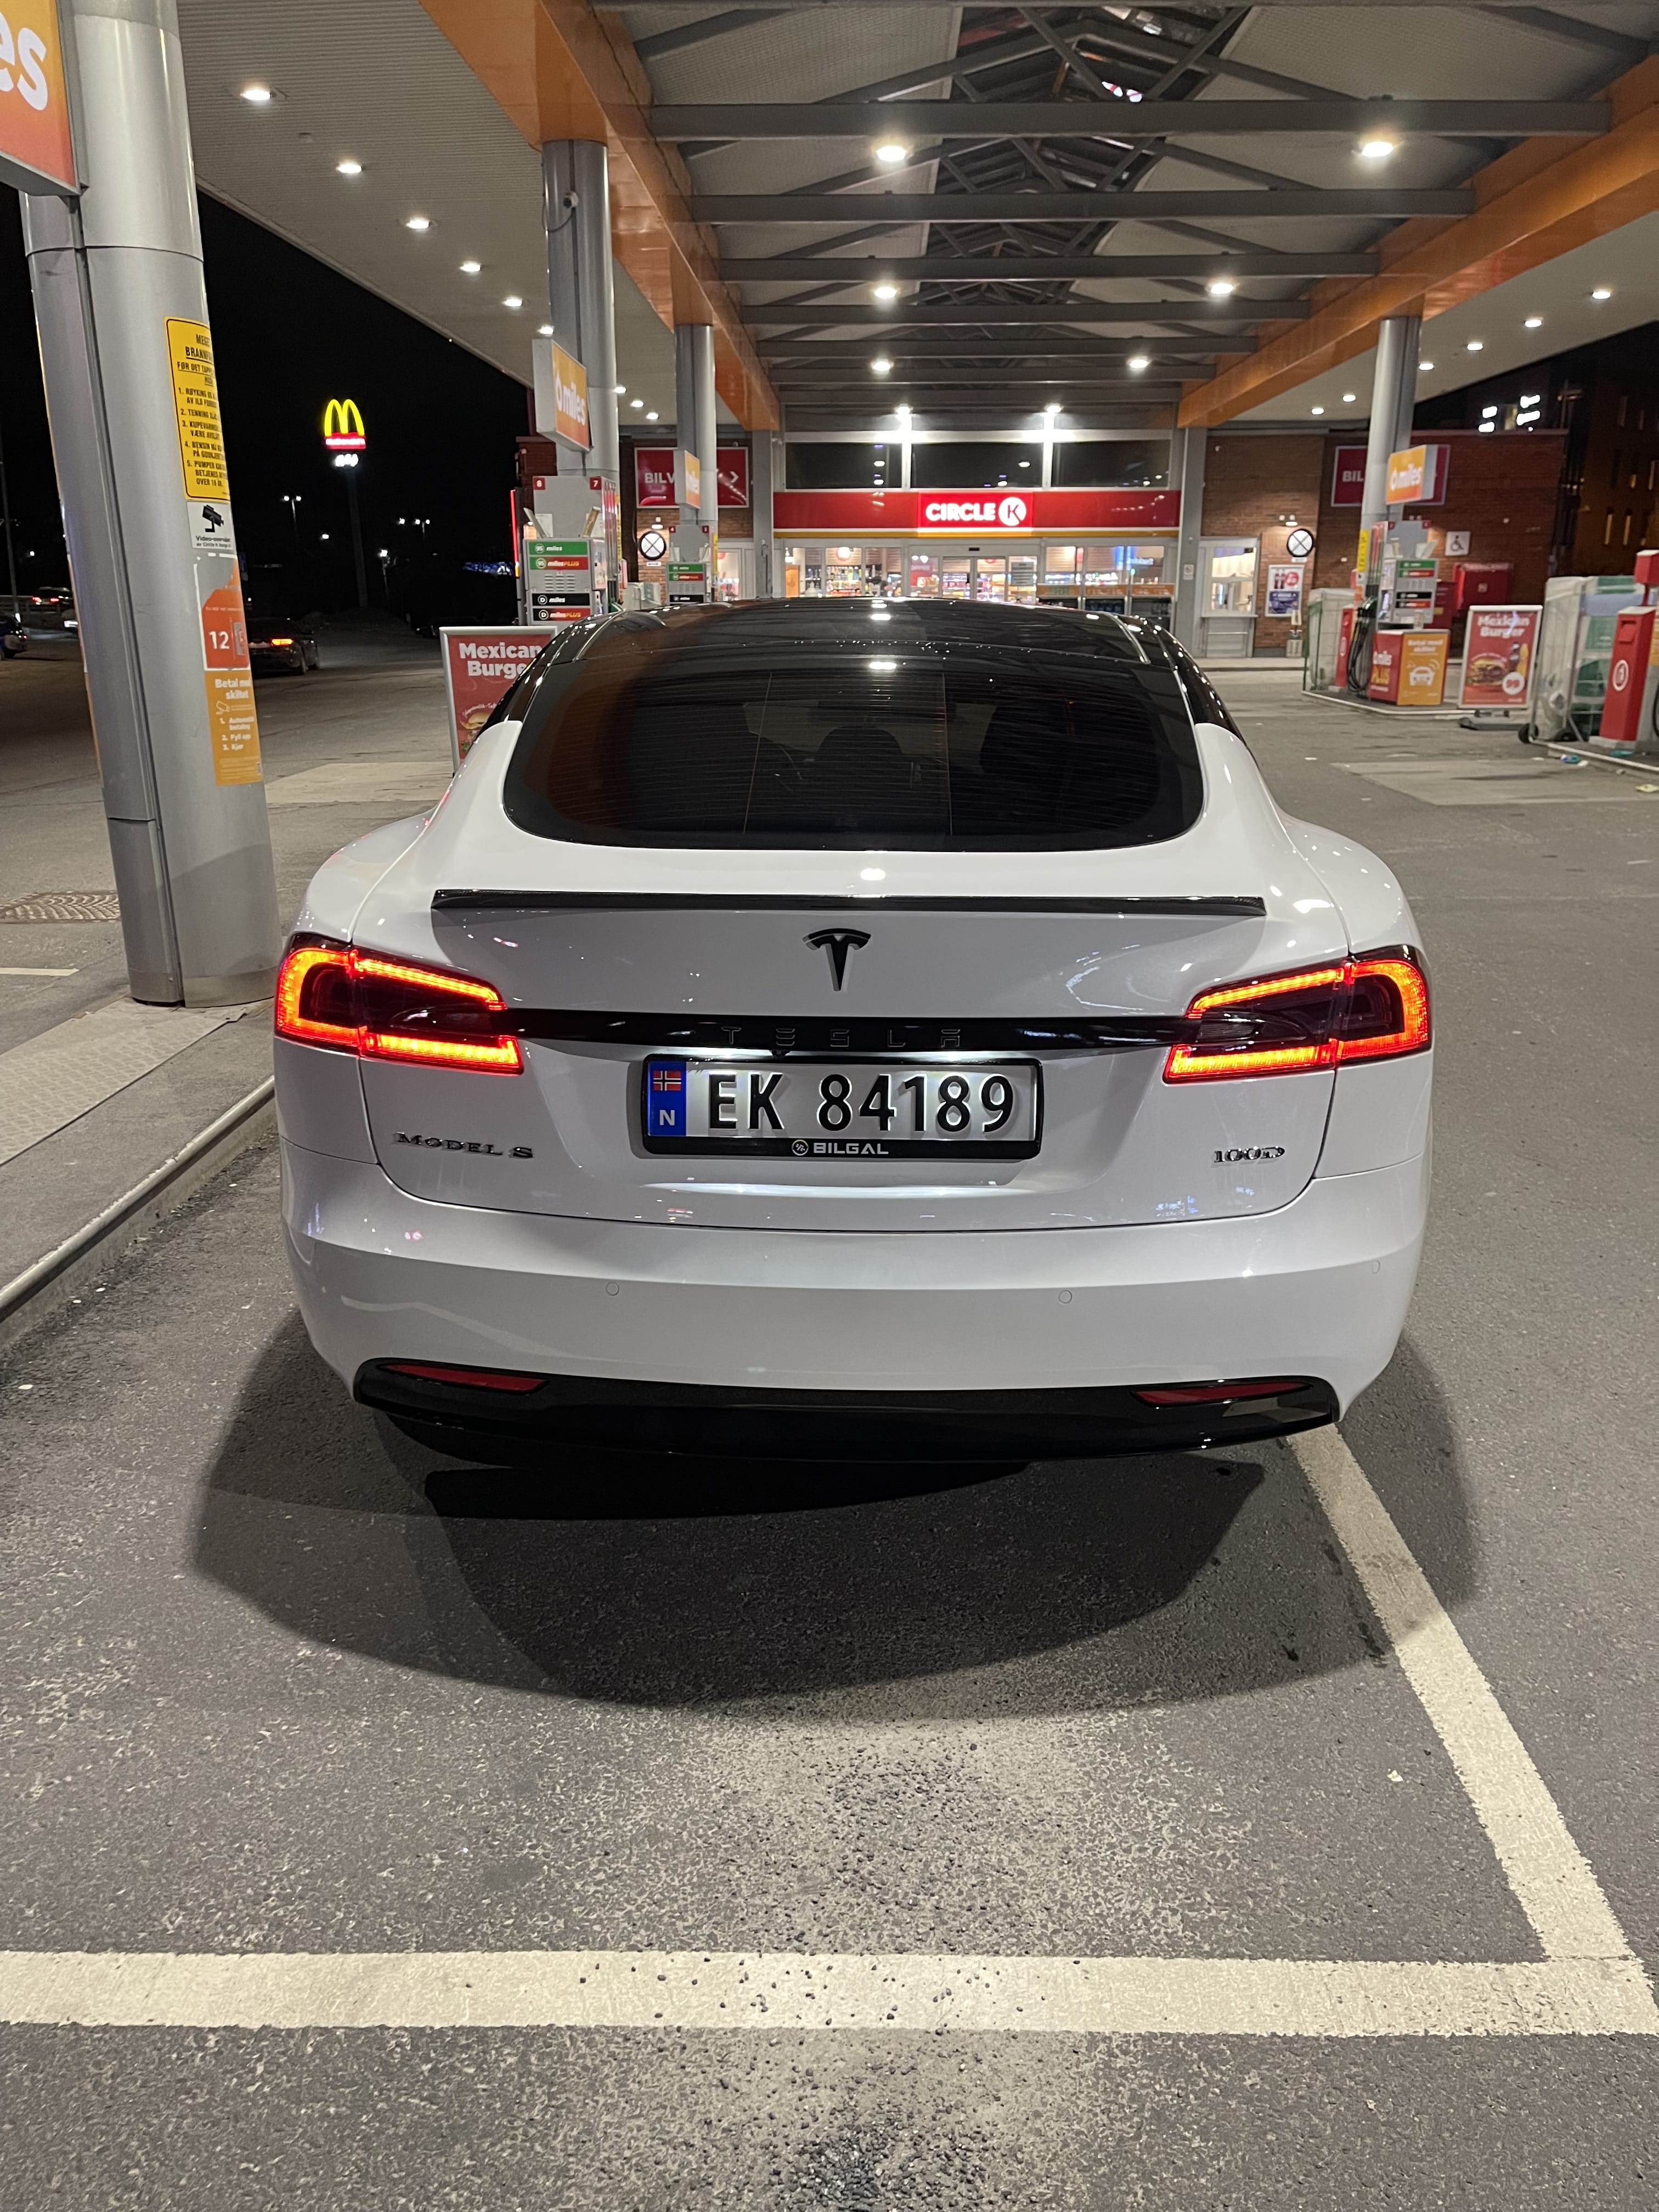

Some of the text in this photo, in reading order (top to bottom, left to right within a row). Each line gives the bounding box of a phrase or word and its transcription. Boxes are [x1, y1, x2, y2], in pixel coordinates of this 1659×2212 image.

[177, 362, 189, 370] FØR
[191, 364, 200, 372] DET
[563, 382, 586, 426] miles
[926, 503, 996, 521] CIRCLE
[209, 631, 230, 649] 12
[459, 642, 543, 659] Mexican
[467, 661, 527, 679] Burge
[215, 679, 239, 688] Betal
[721, 1026, 961, 1048] TESLA
[708, 1071, 1014, 1133] EK 84189
[659, 1110, 675, 1126] N
[393, 1132, 533, 1159] MODEL S
[814, 1143, 889, 1154] BILGAL
[1214, 1146, 1285, 1164] 100D
